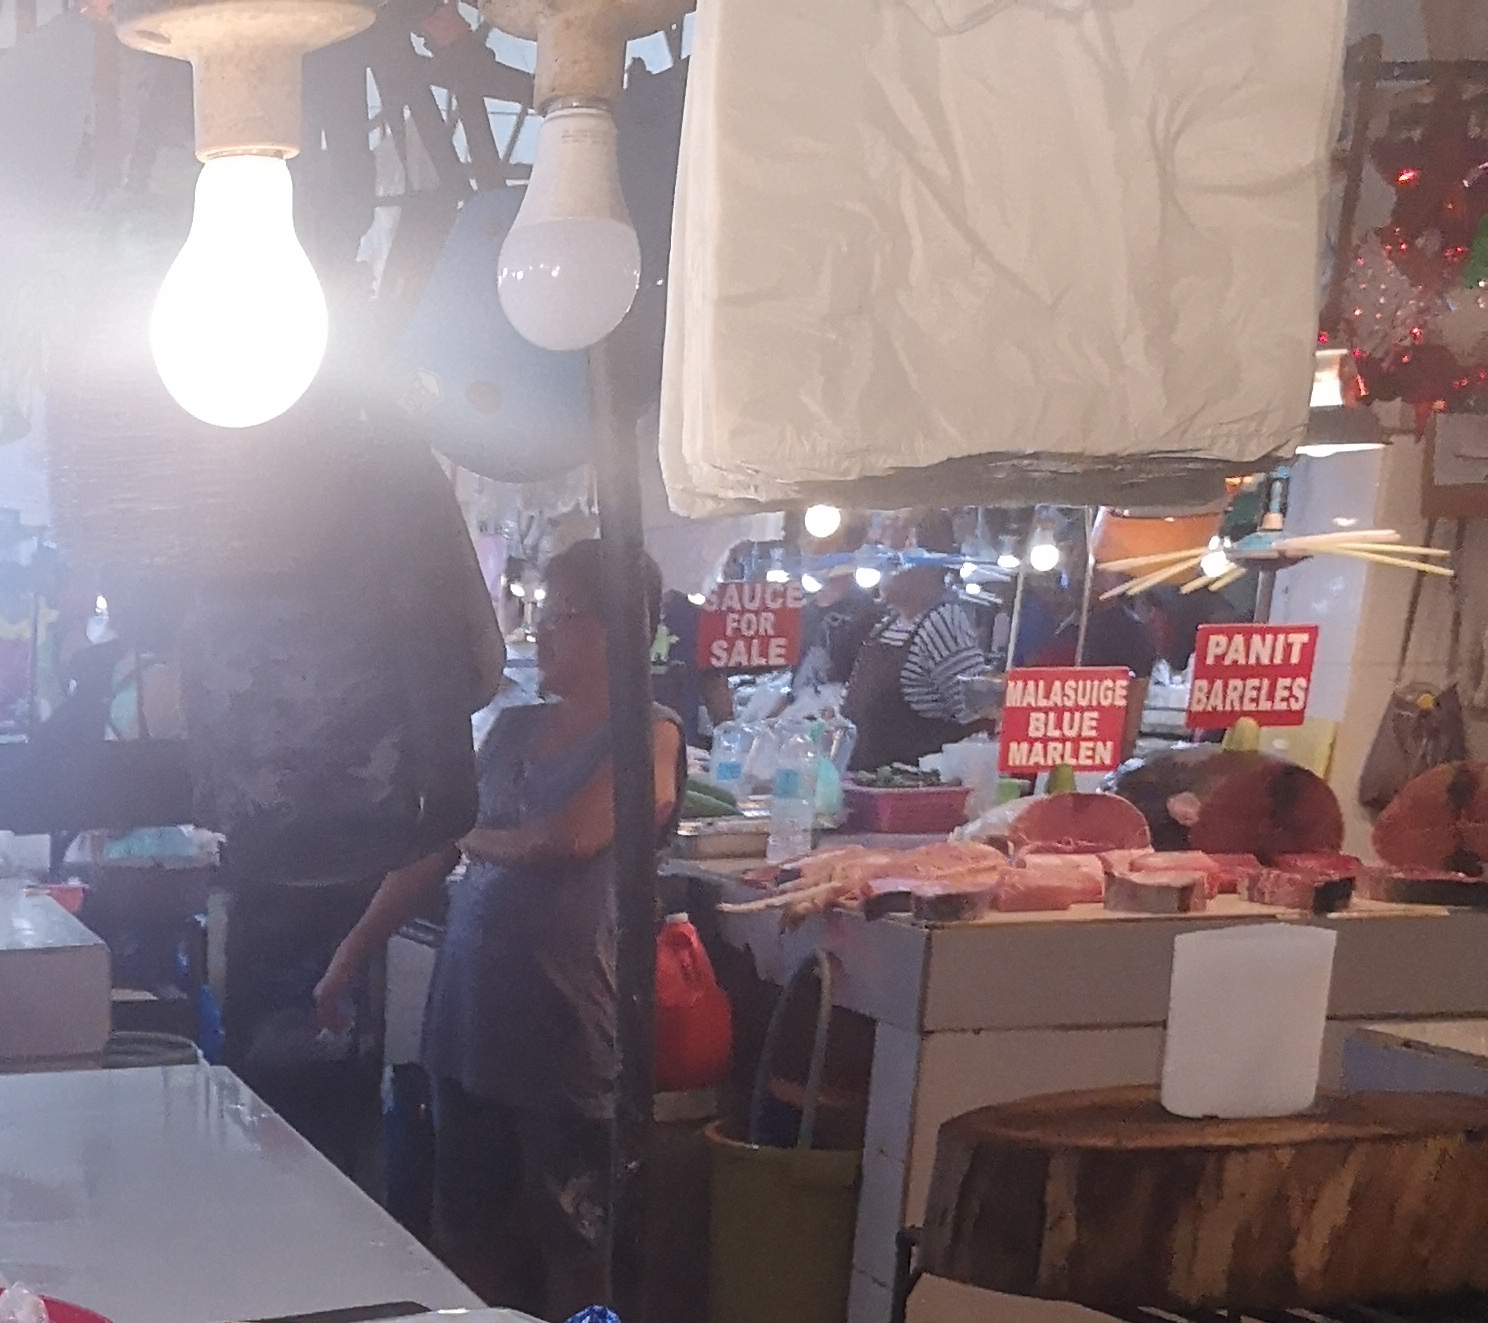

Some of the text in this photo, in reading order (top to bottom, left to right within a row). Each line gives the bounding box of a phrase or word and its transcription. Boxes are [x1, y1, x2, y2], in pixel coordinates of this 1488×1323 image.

[725, 611, 775, 637] FOR
[709, 637, 788, 667] SALE
[1205, 633, 1310, 666] PANIT
[1006, 679, 1128, 708] MALASUIGE
[1190, 677, 1309, 712] BARELES
[1028, 711, 1098, 738] BLUE
[1008, 740, 1114, 766] MARLEN
